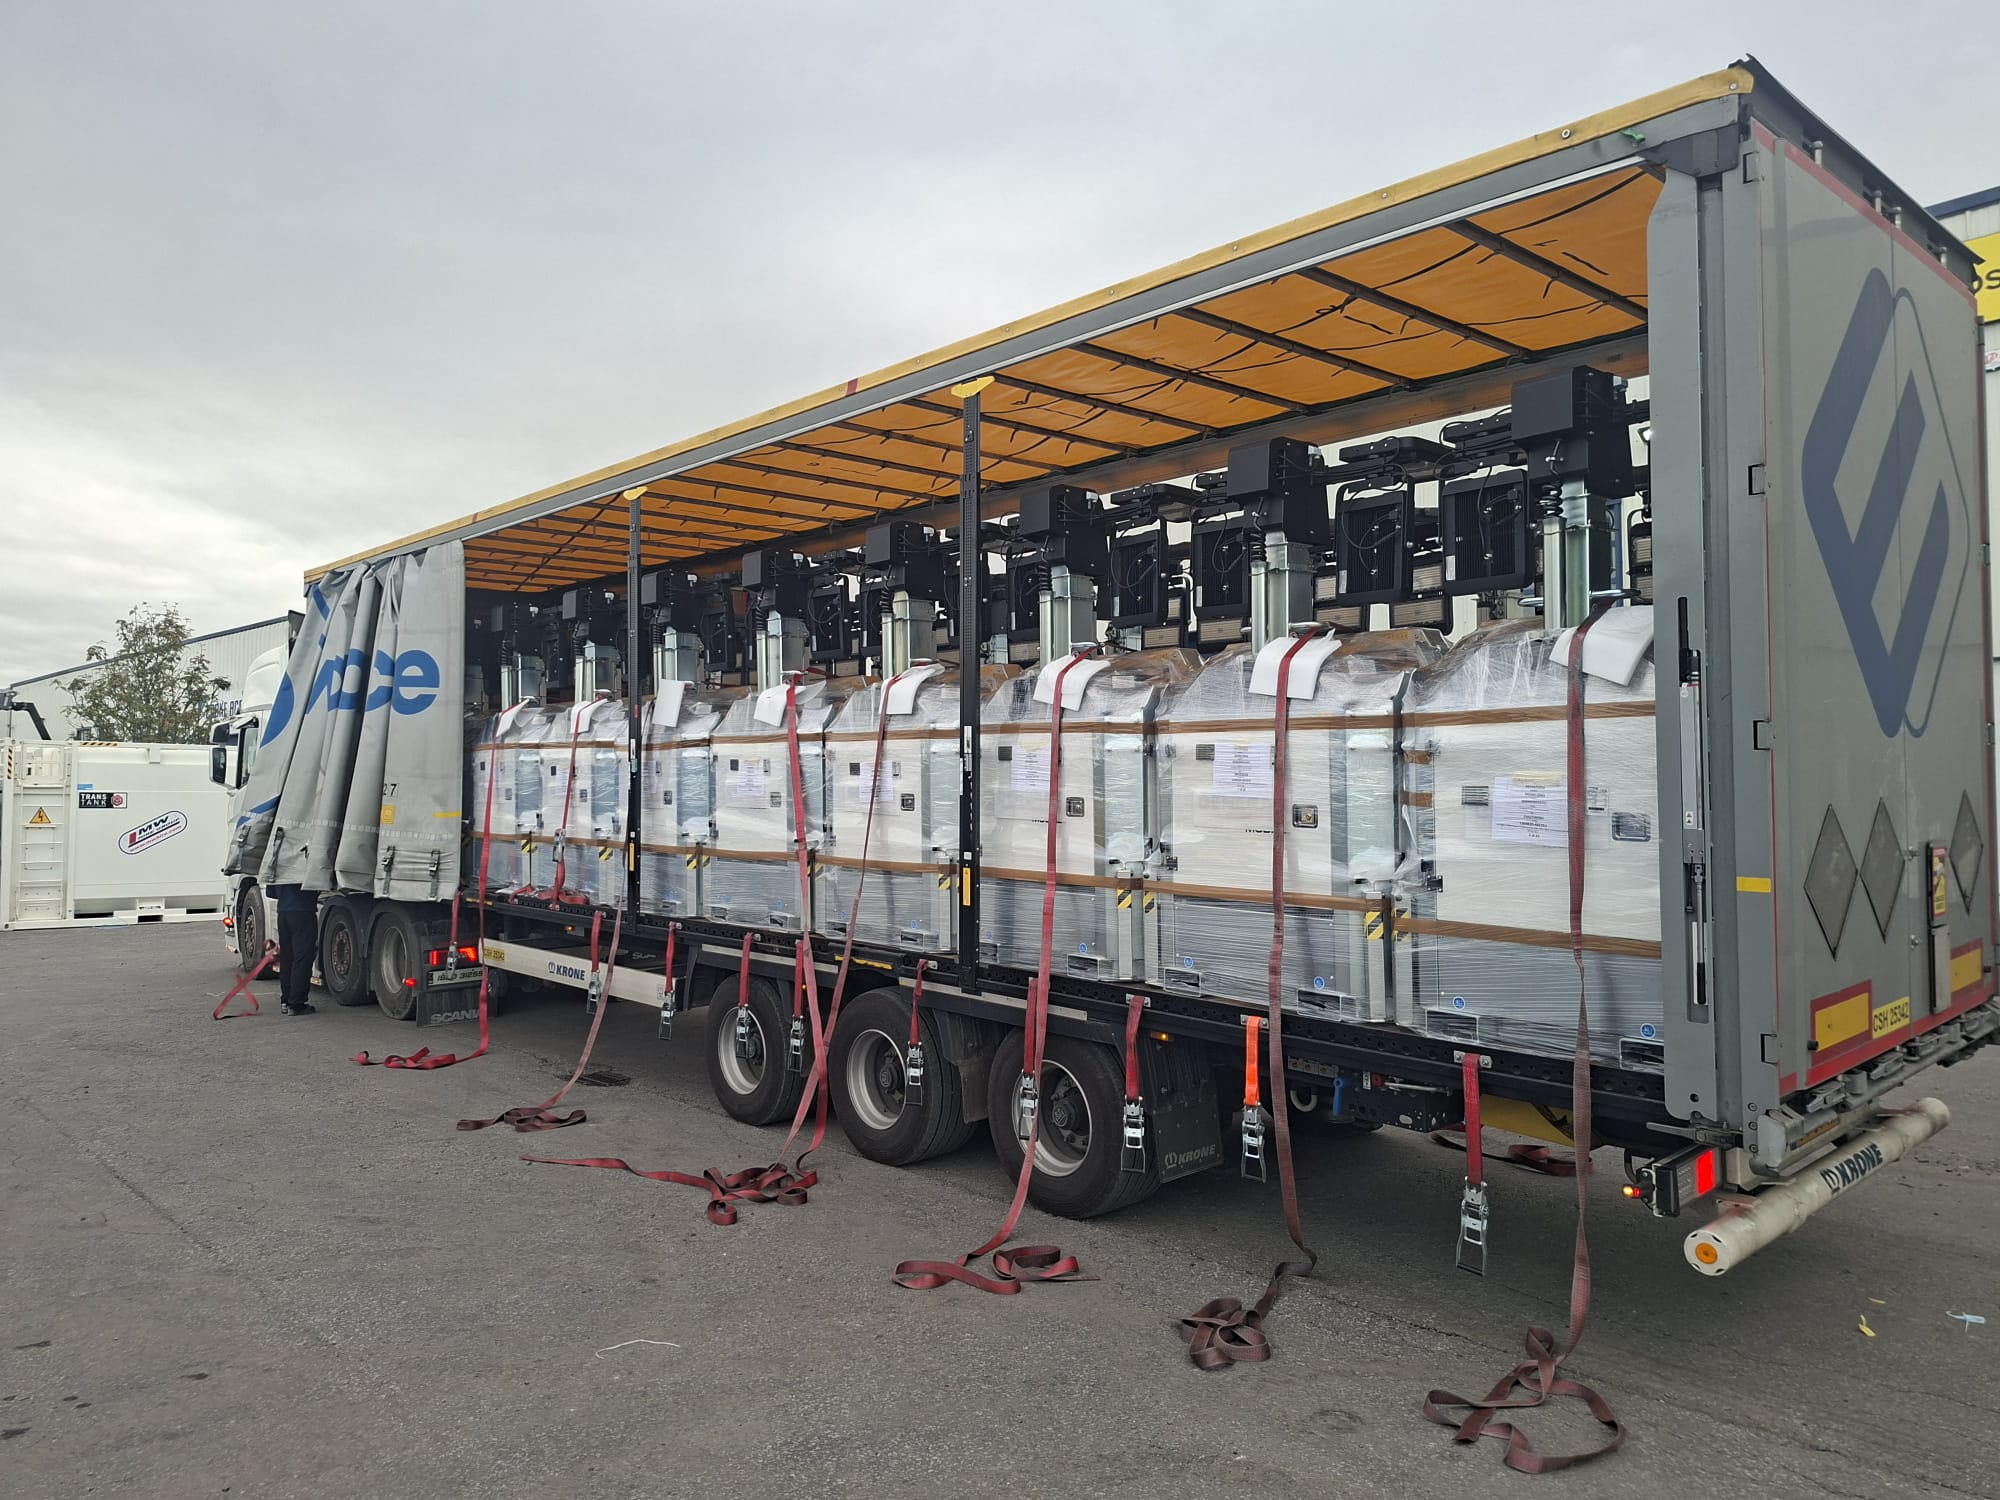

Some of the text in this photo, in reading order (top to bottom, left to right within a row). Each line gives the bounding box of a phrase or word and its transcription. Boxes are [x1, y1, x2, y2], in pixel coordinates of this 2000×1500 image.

[556, 964, 586, 981] KRONE
[1873, 1001, 1909, 1033] CSH 25342
[1178, 1143, 1216, 1165] KRONE
[1834, 1143, 1883, 1188] KRONE
